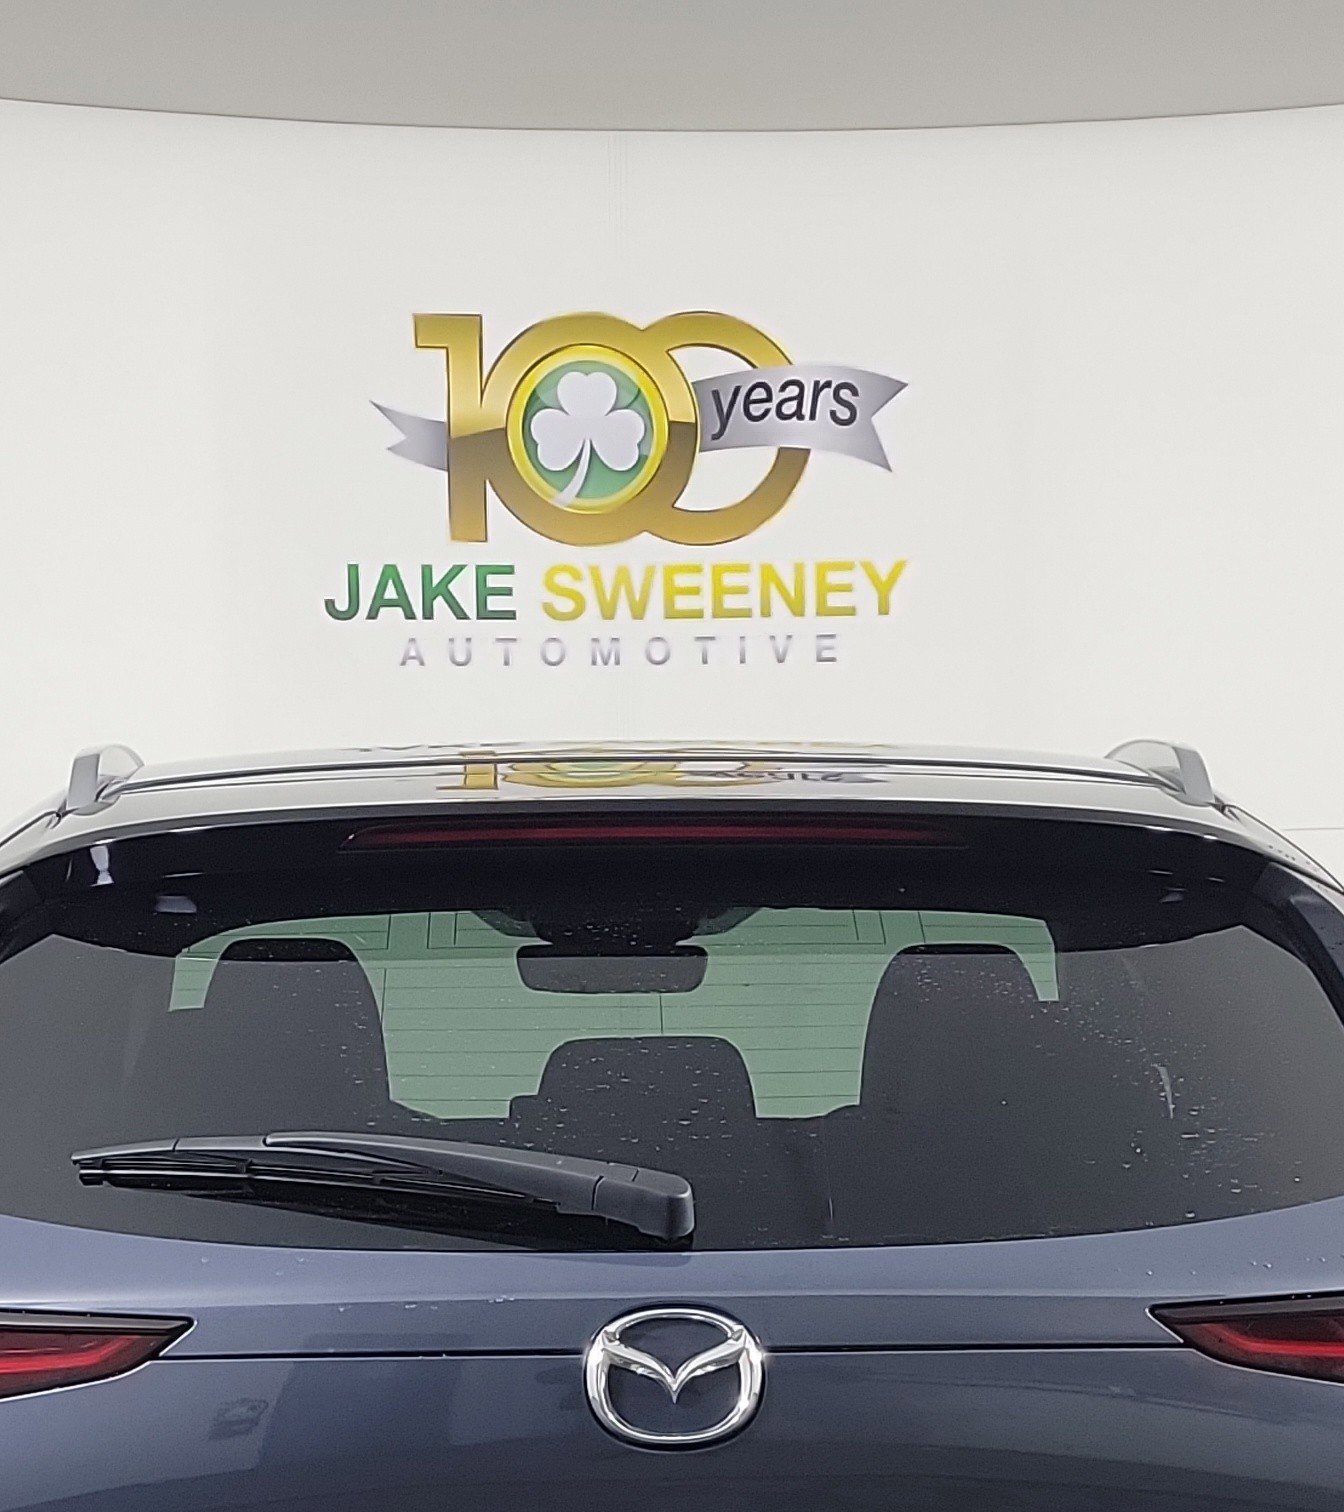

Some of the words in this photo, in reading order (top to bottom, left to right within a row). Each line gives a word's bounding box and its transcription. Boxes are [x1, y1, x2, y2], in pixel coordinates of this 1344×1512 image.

[413, 311, 811, 546] 100
[710, 376, 860, 441] years
[324, 563, 516, 621] JAKE
[541, 559, 908, 621] SWEENEY
[400, 633, 838, 667] AUTOMOTIVE
